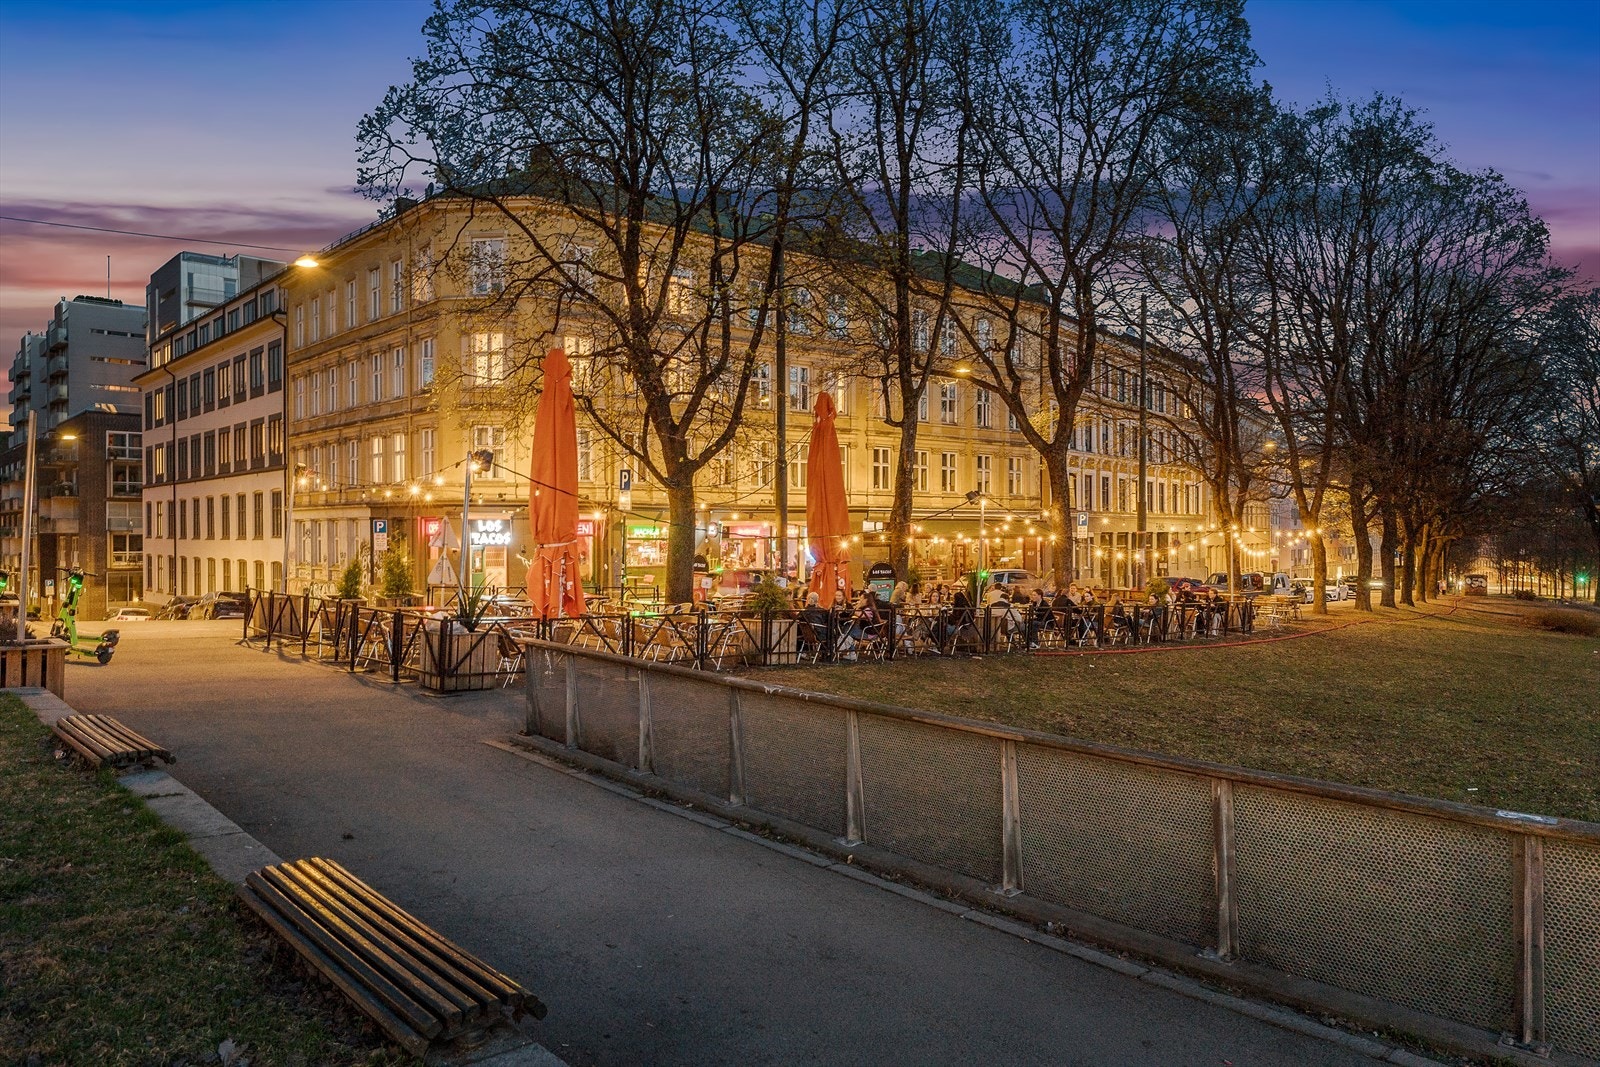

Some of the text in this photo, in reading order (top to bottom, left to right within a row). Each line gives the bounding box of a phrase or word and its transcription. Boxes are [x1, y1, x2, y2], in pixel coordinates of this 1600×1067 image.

[621, 471, 629, 488] P
[1079, 514, 1087, 525] P
[376, 521, 384, 532] P
[478, 520, 502, 532] LOS
[471, 532, 511, 545] TACOS
